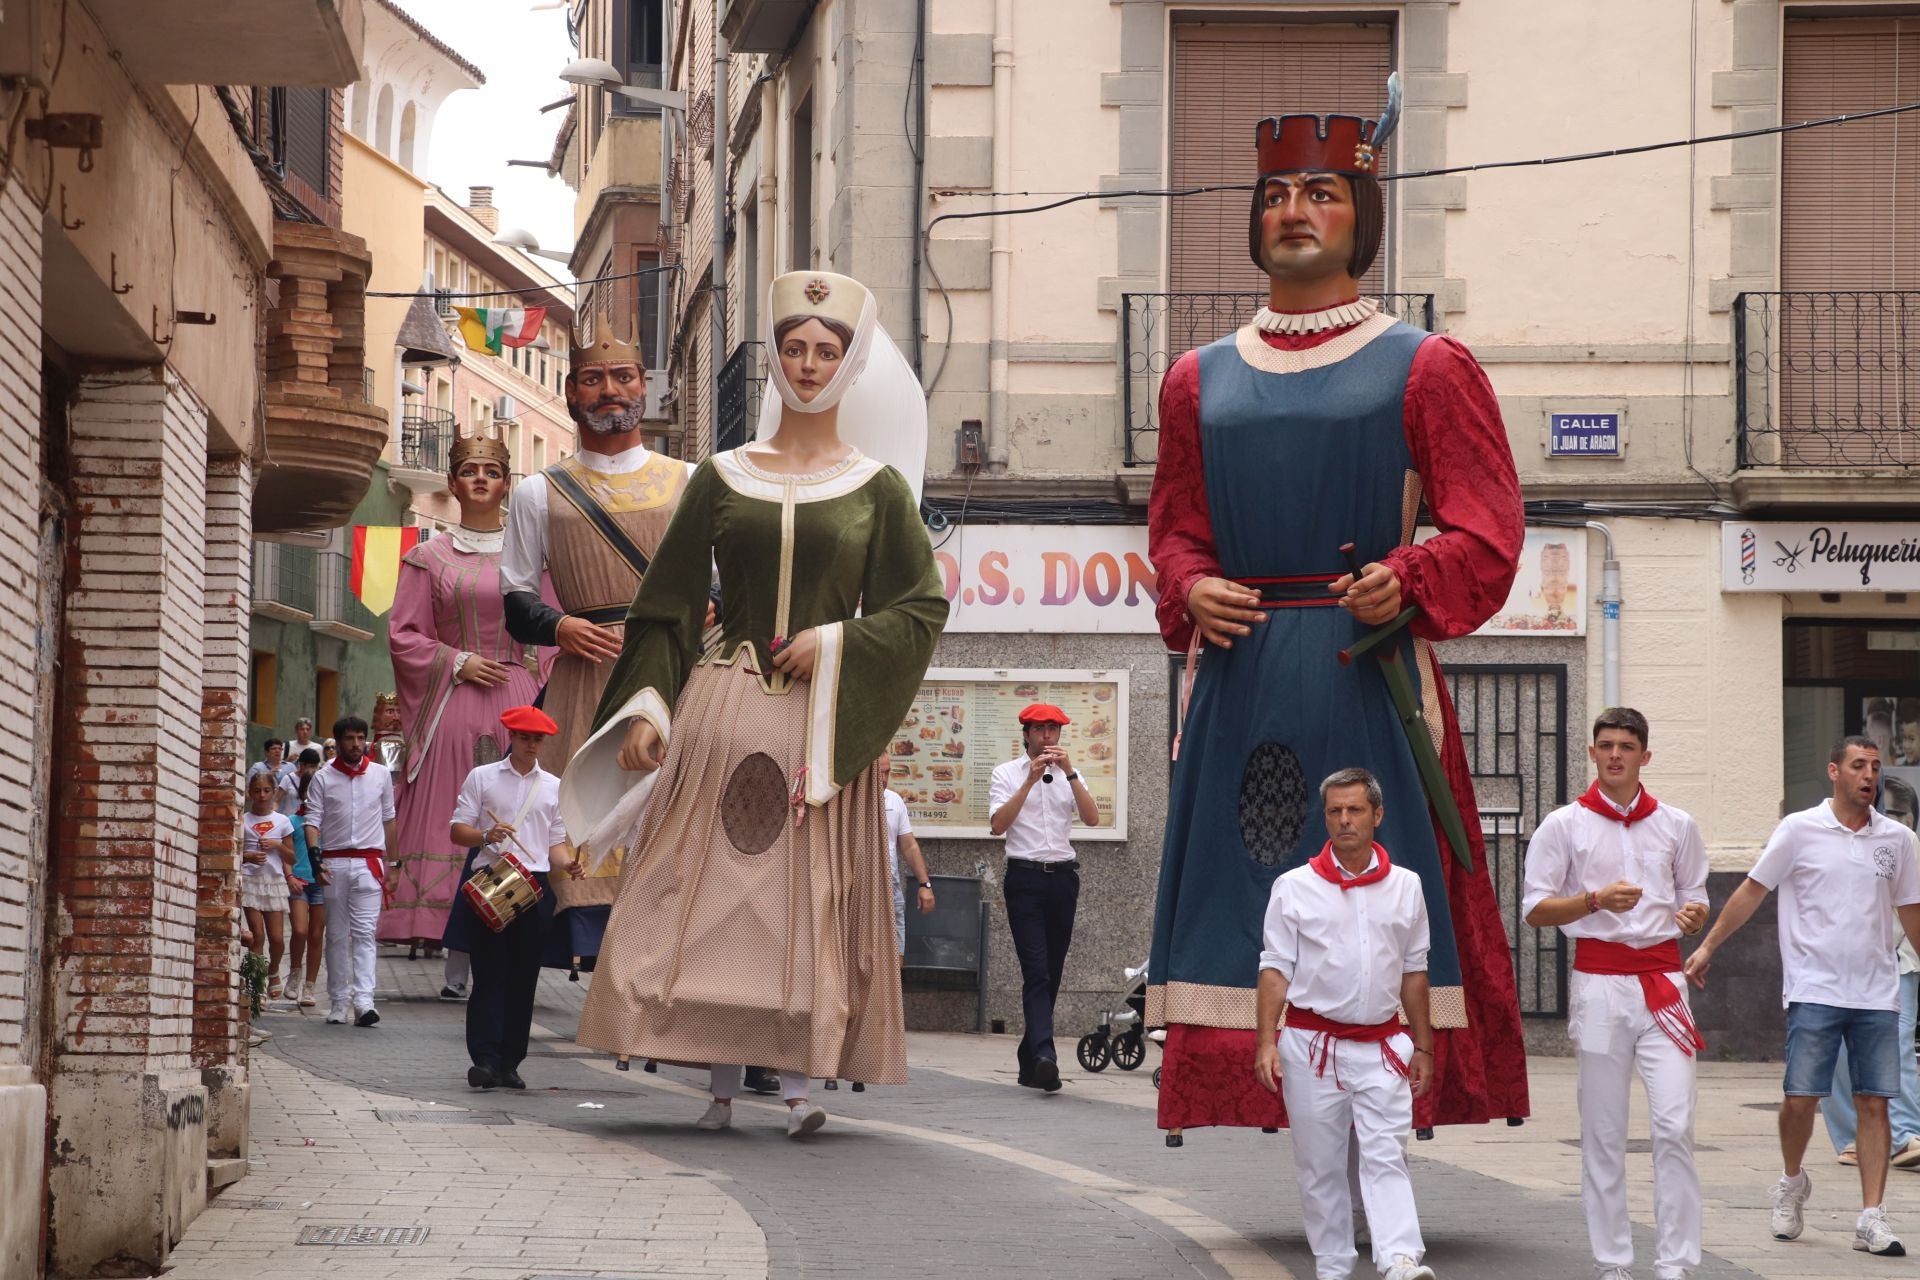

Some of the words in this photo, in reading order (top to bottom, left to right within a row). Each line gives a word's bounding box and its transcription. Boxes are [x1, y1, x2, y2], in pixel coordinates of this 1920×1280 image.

[1560, 419, 1610, 429] CALLE
[1560, 435, 1578, 450] JUAN
[1580, 437, 1589, 450] DE
[1589, 435, 1616, 450] ARAGON
